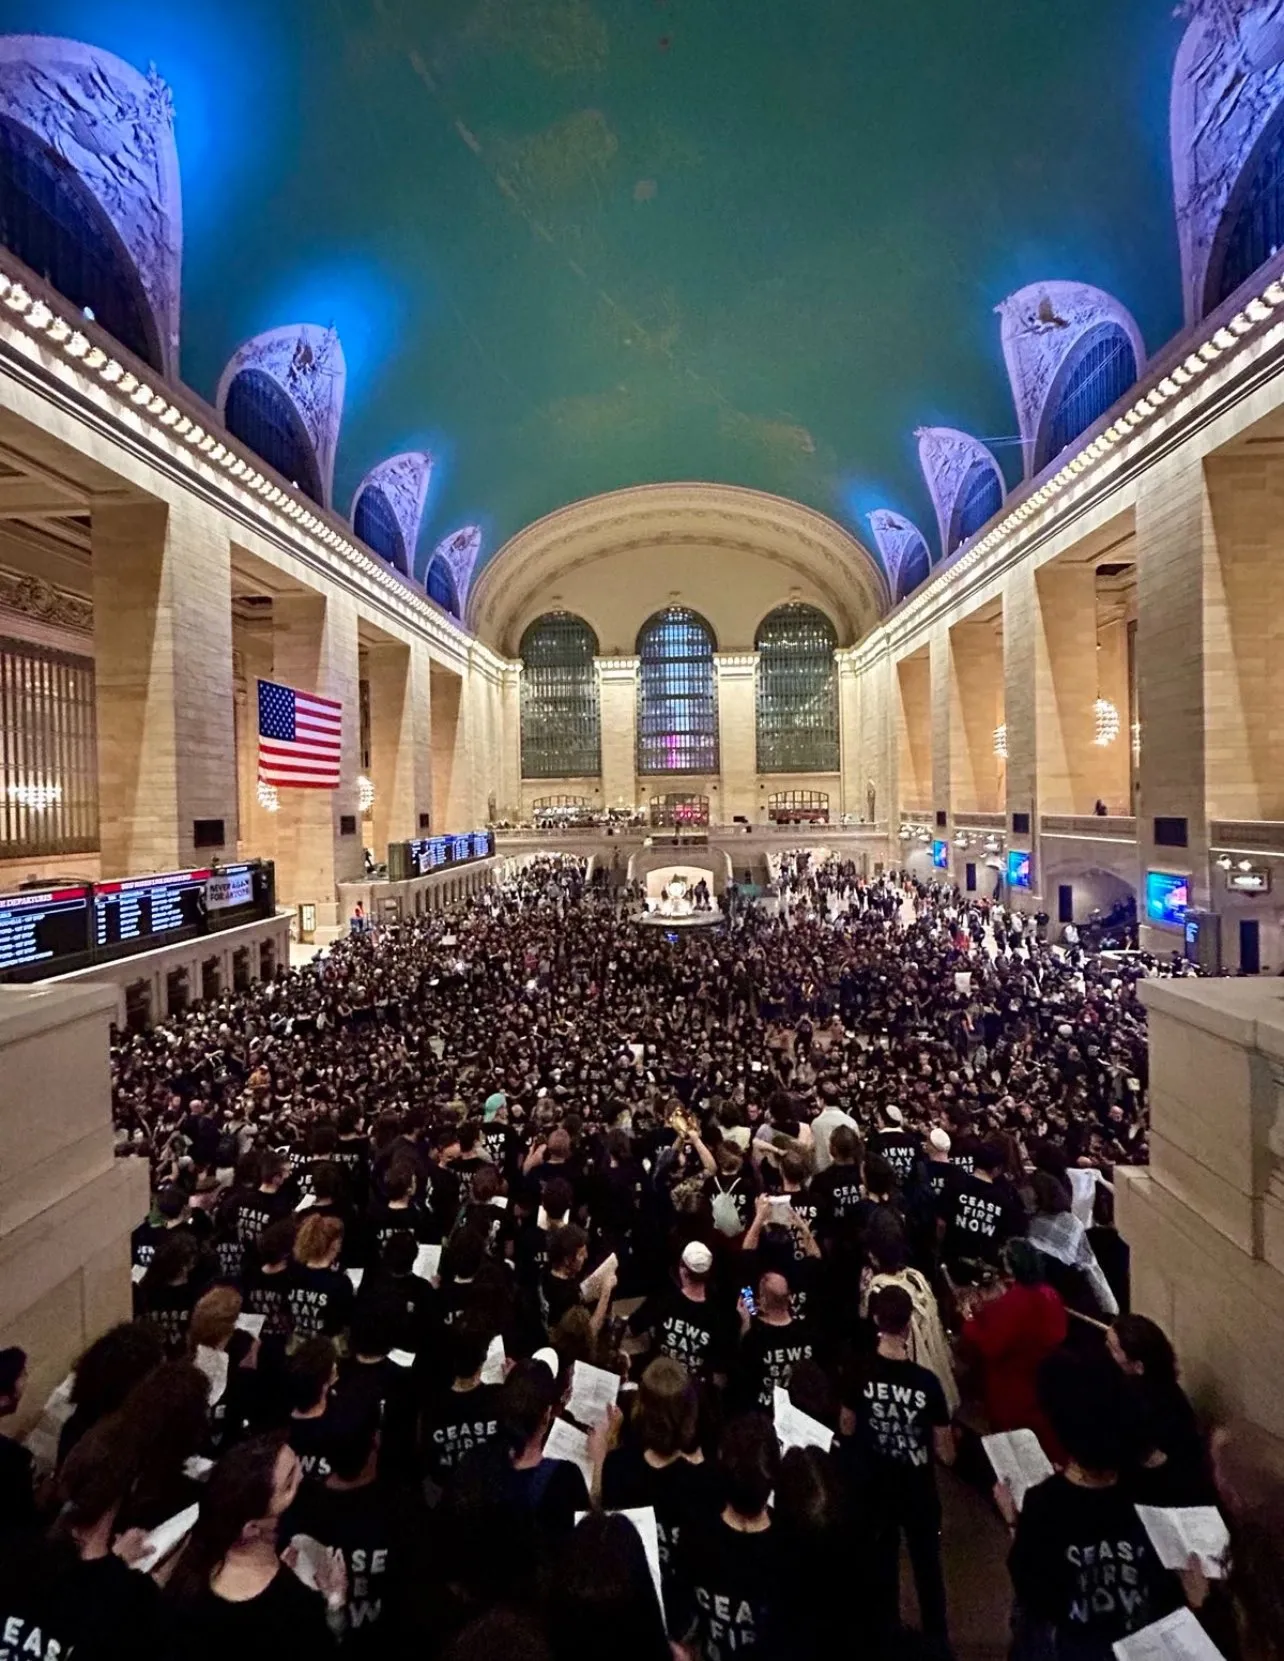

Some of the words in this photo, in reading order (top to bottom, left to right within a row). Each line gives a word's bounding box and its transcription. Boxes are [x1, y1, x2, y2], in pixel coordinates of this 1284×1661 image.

[880, 1147, 916, 1158] JEWS
[958, 1193, 1002, 1218] CEASE
[963, 1205, 995, 1224] FIRE
[955, 1213, 996, 1238] NOW
[287, 1288, 329, 1307] JEWS
[291, 1301, 320, 1318] SAY
[662, 1316, 711, 1346] JEWS
[666, 1332, 700, 1353] SAY
[762, 1344, 813, 1365] JEWS
[862, 1380, 927, 1410] JEWS
[871, 1400, 919, 1425] SAY
[432, 1419, 498, 1444] CEASE
